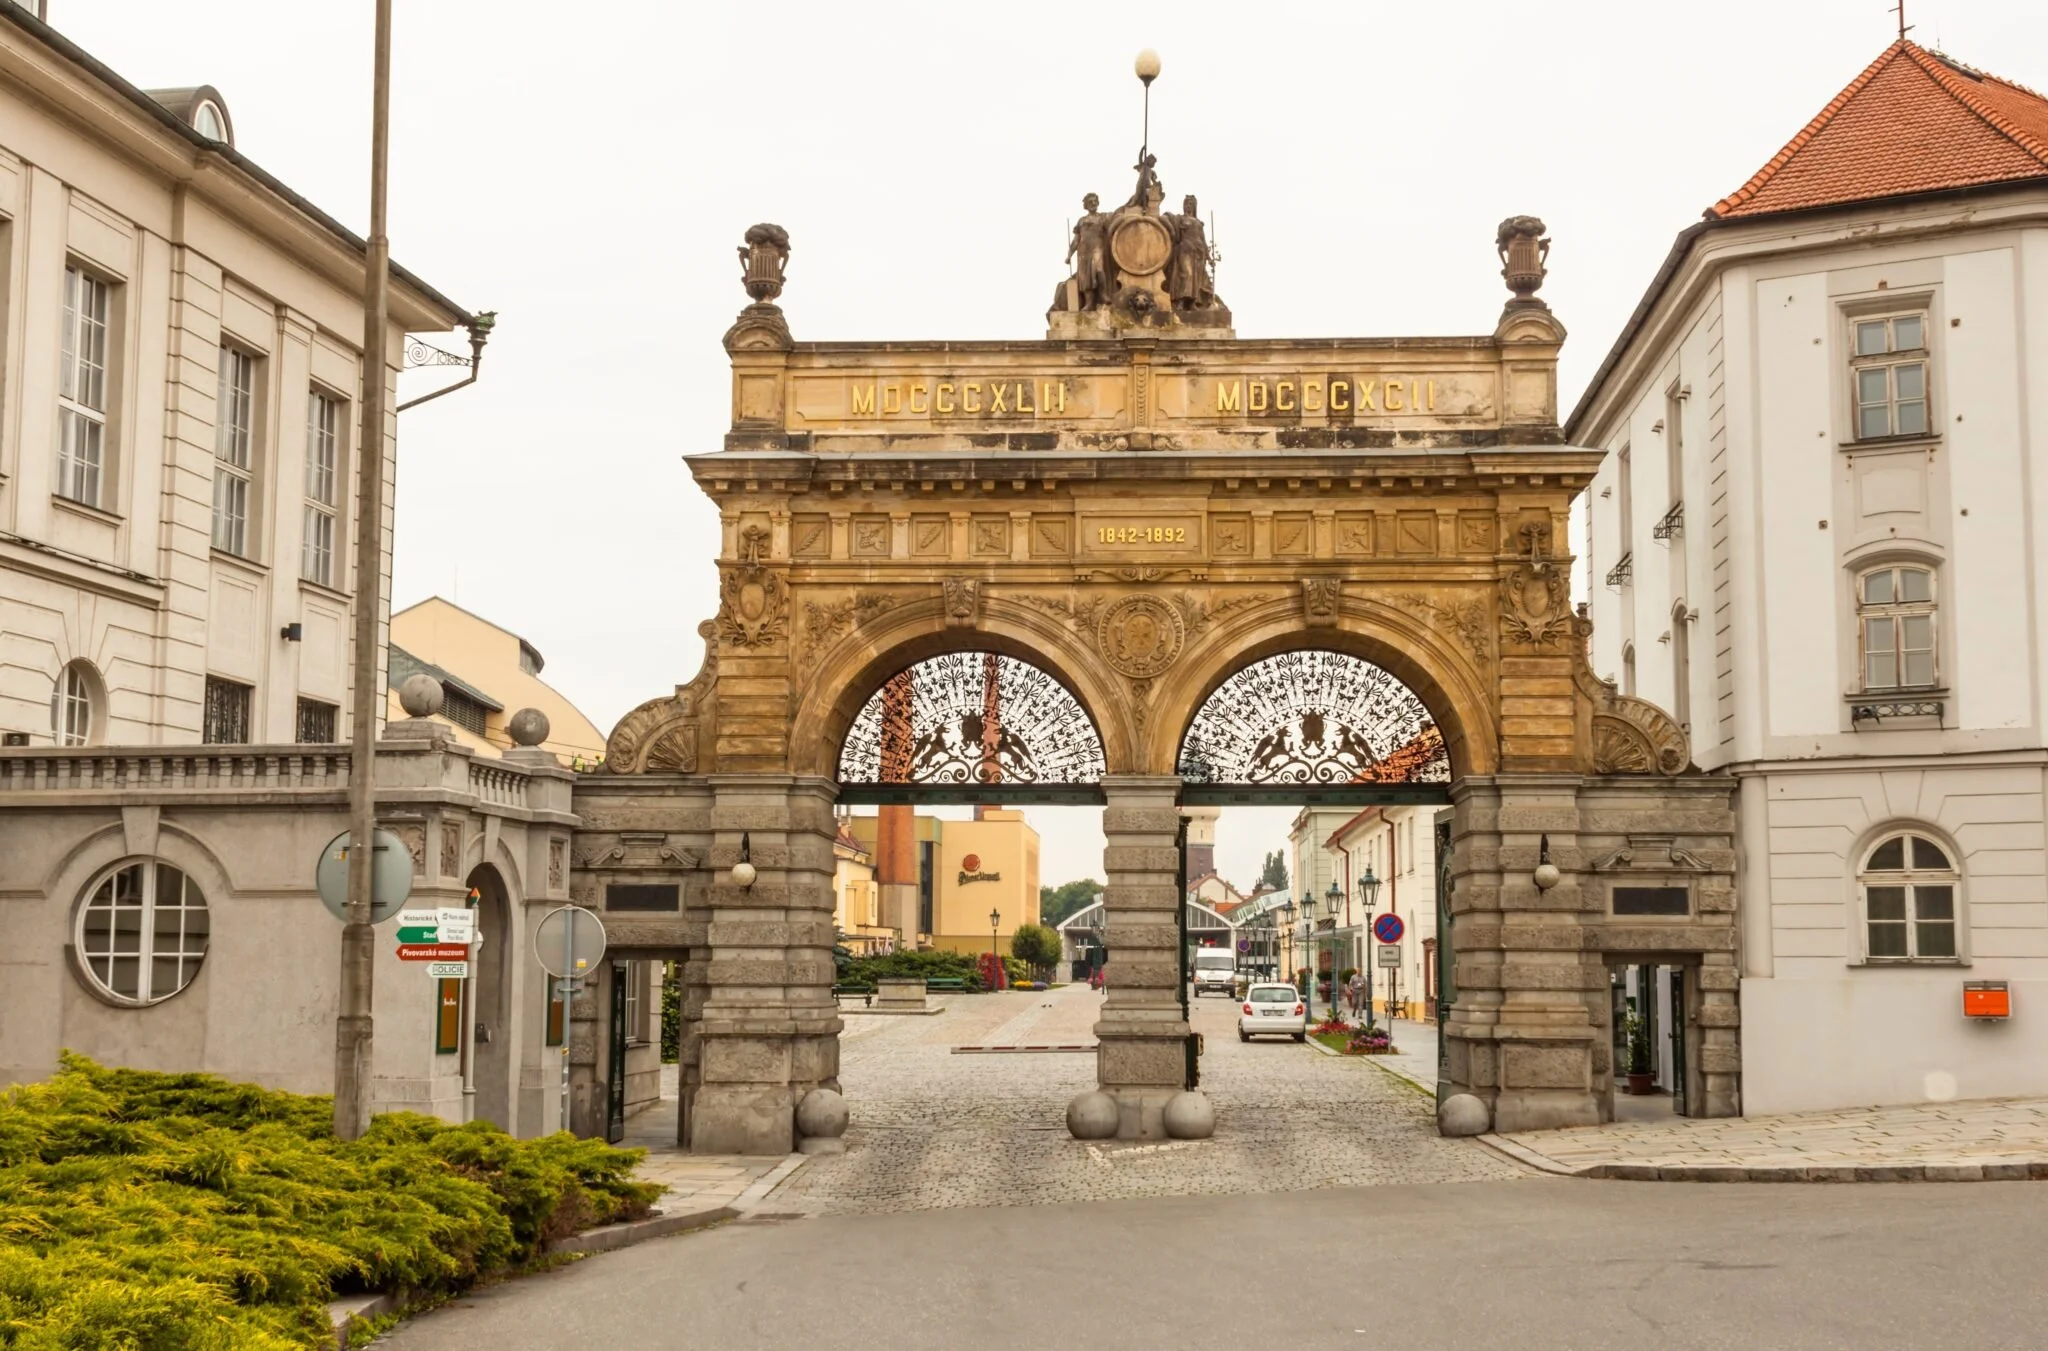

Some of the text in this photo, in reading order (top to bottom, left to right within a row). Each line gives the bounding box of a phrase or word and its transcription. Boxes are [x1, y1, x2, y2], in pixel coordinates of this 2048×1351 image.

[852, 383, 1065, 414] MDCCCXLII
[1217, 381, 1434, 411] MDCCCXCII
[1098, 527, 1185, 543] 1842-1892
[402, 948, 437, 957] Pivovarské
